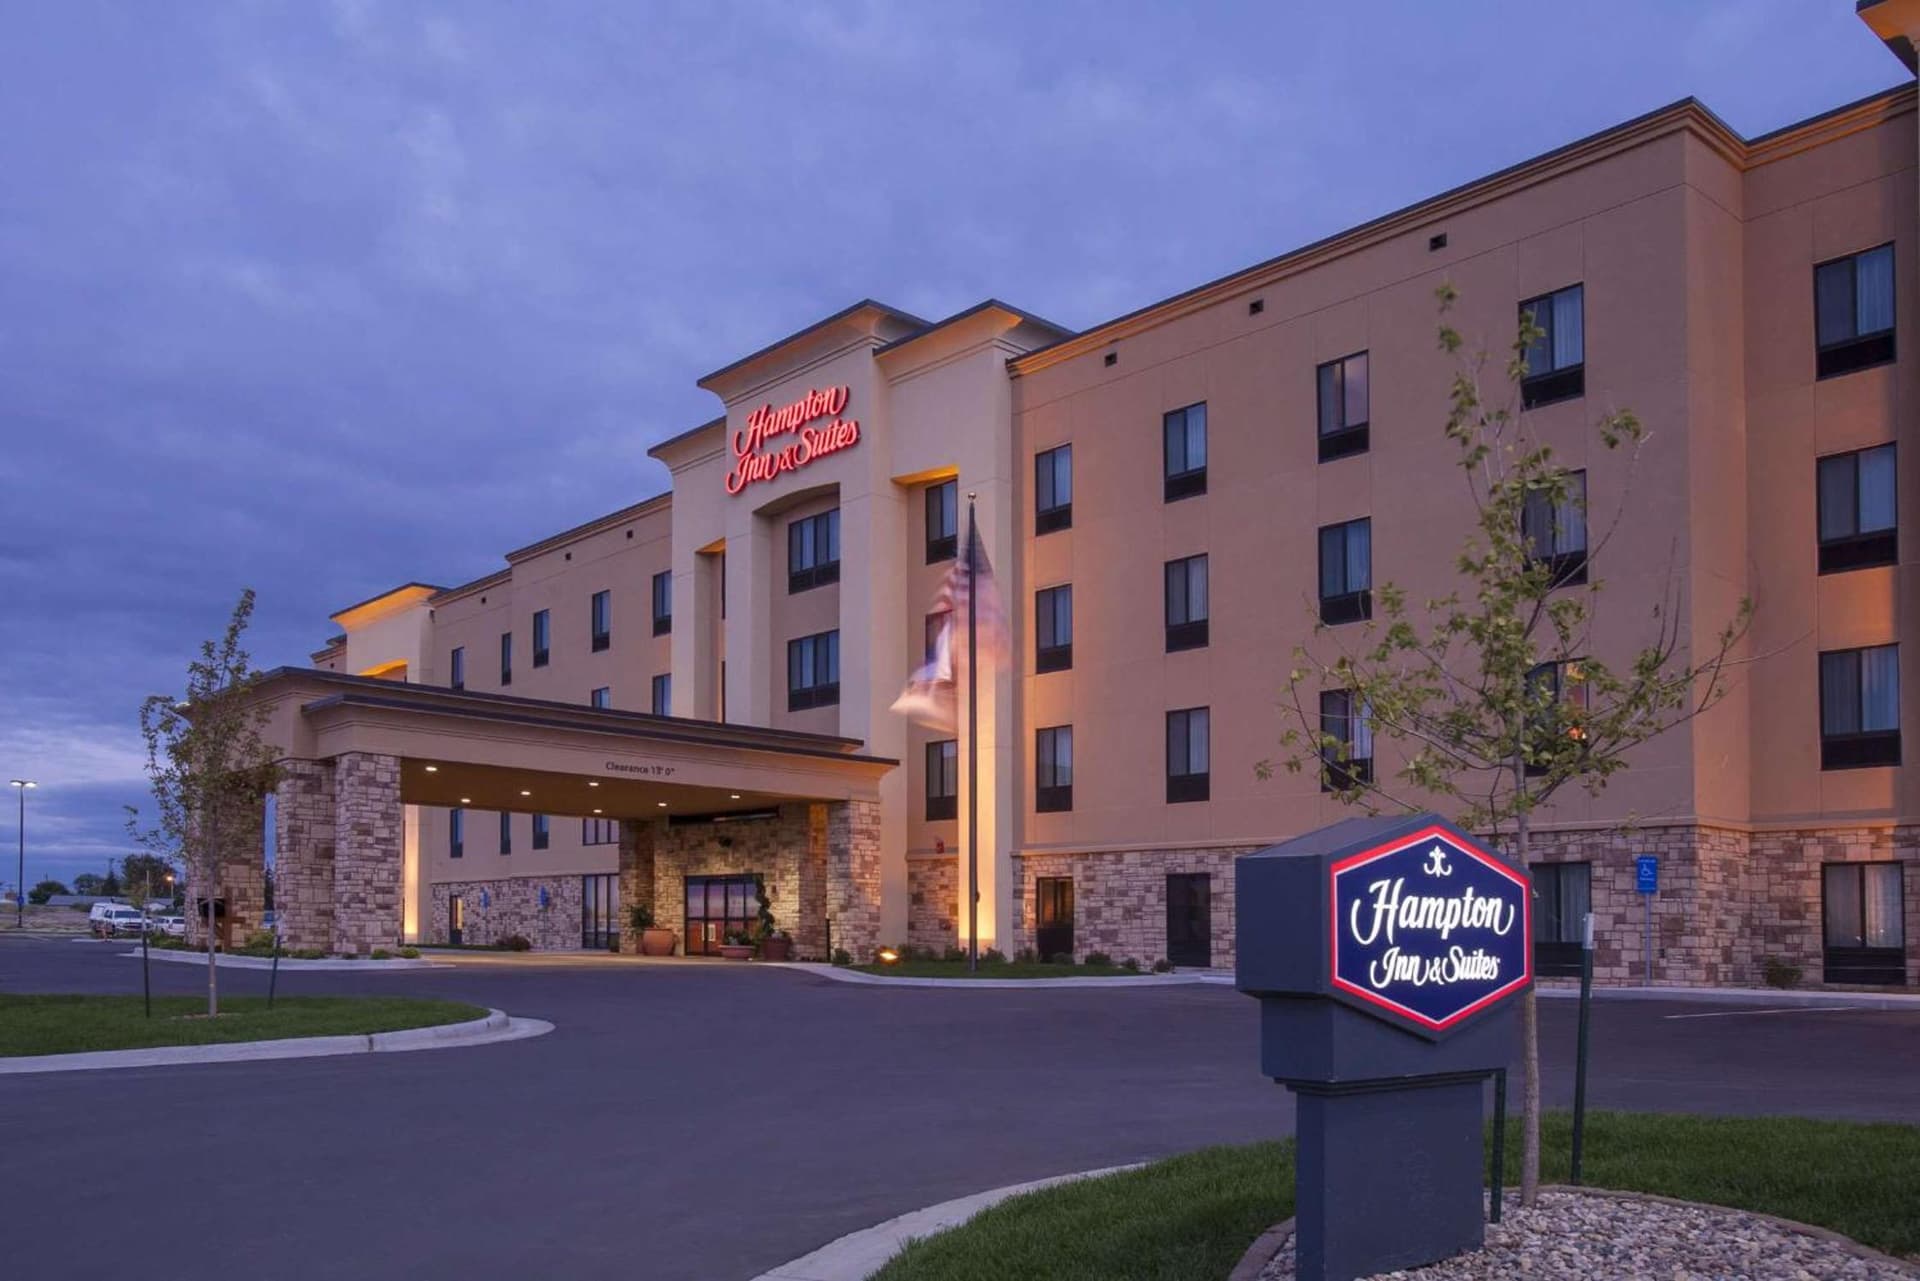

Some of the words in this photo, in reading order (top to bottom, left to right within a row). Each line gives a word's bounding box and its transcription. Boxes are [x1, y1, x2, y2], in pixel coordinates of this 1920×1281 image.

[733, 384, 849, 457] Hampton
[726, 452, 782, 495] Inn
[780, 446, 795, 471] &
[793, 418, 859, 466] Suites
[605, 761, 649, 774] Clearance
[1351, 877, 1515, 945] Hampton
[1370, 946, 1430, 988] Inn
[1429, 959, 1445, 985] &
[1442, 945, 1500, 983] Suites
